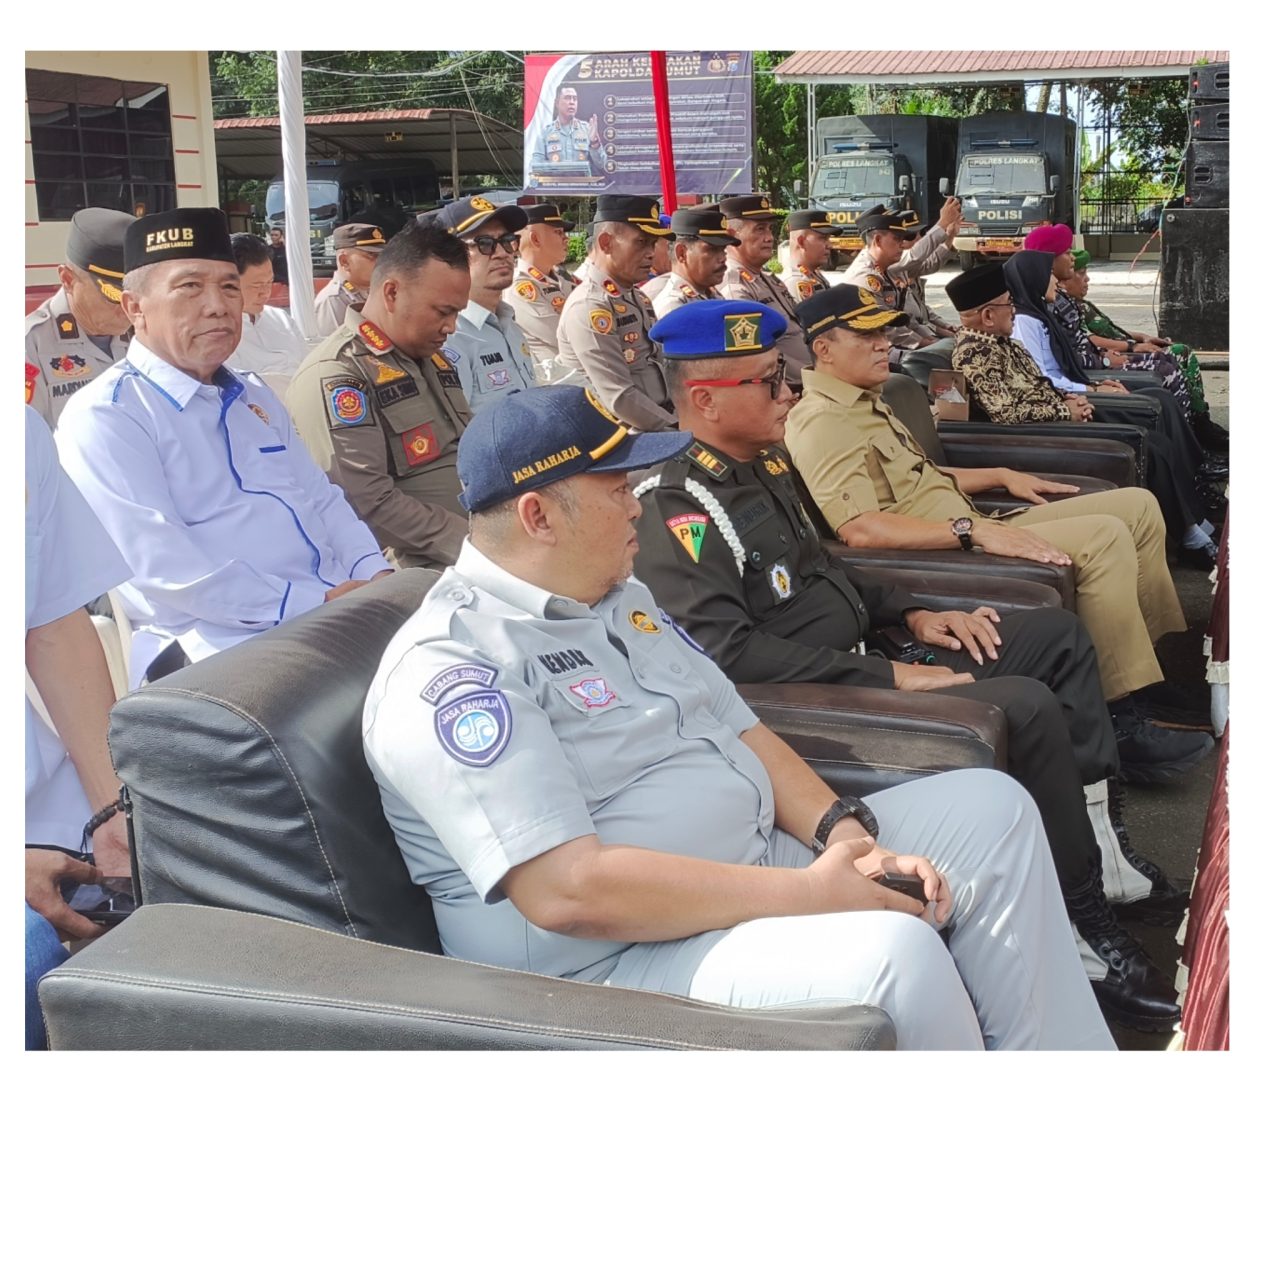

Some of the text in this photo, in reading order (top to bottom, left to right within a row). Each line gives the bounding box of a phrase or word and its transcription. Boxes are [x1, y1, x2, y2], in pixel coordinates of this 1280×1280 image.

[578, 59, 593, 79] 5
[666, 65, 701, 76] UMUT
[978, 210, 1022, 220] POLISI
[146, 227, 194, 247] FKUB
[512, 445, 582, 484] JASA RAHARJA
[428, 669, 490, 697] CABANG SUMUT
[441, 699, 499, 725] JASA RAHARJA
